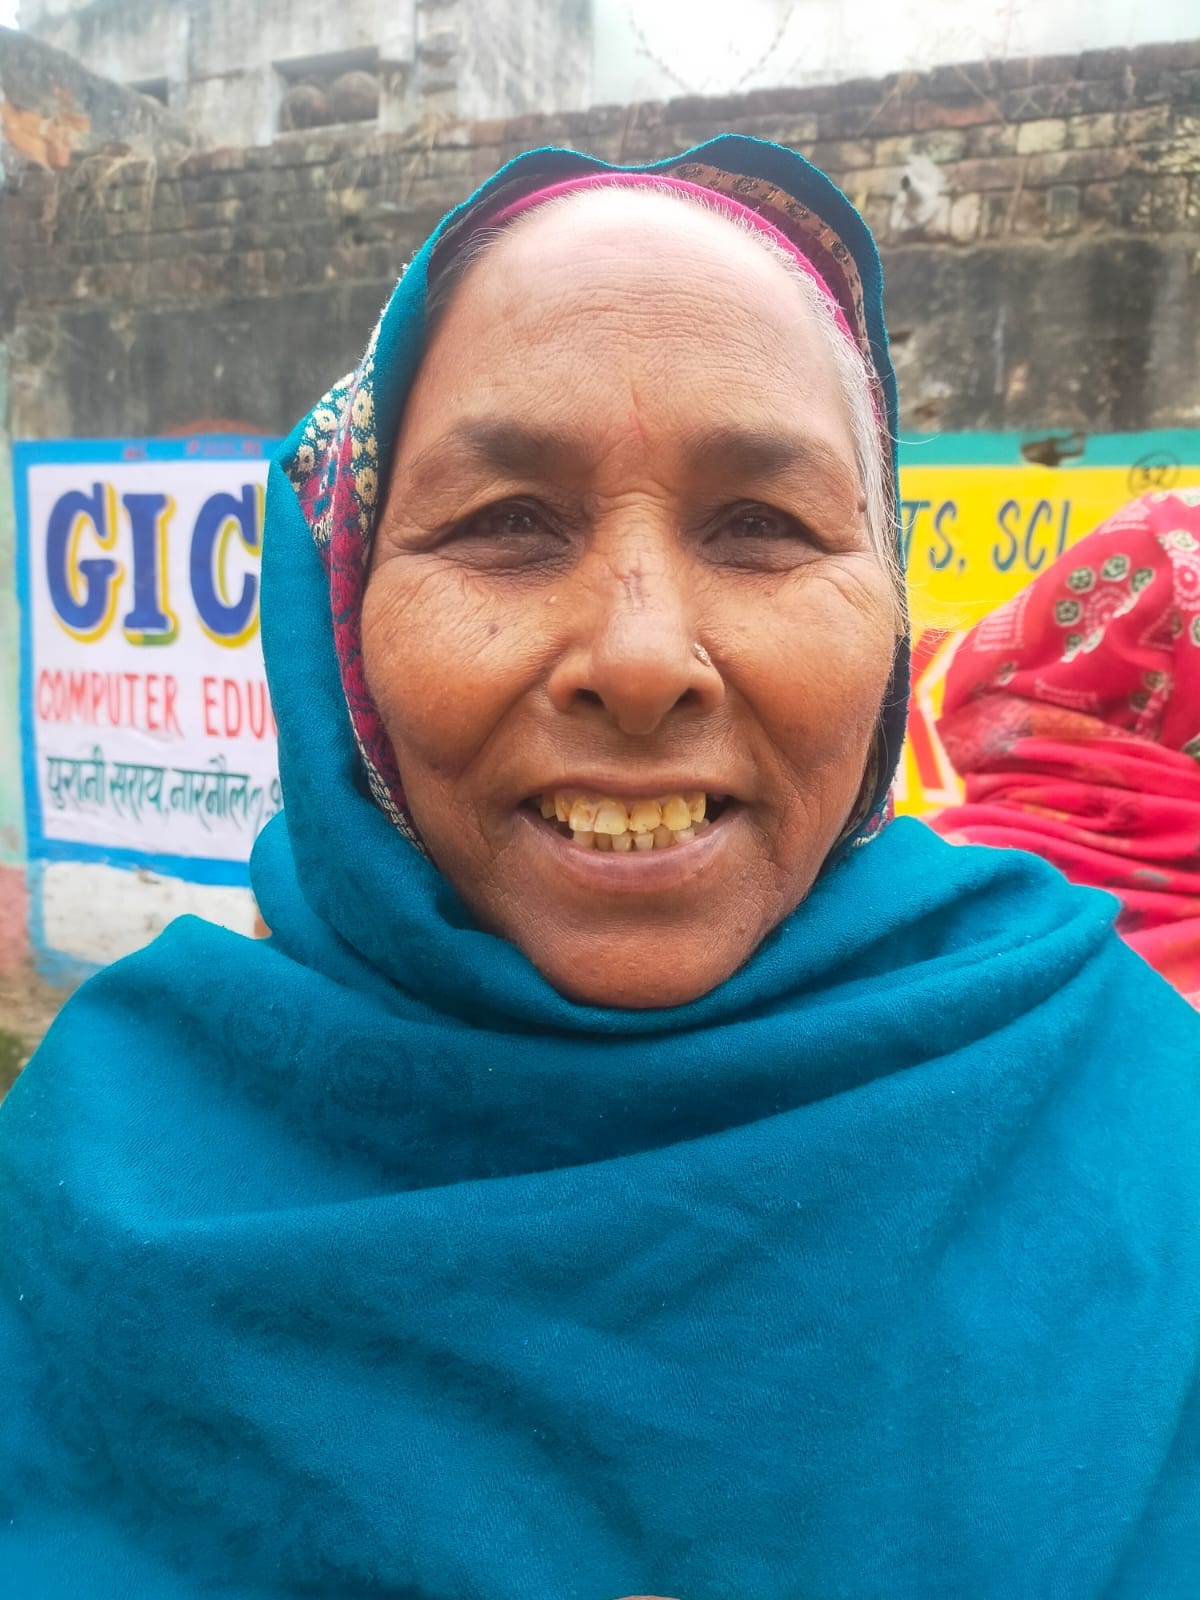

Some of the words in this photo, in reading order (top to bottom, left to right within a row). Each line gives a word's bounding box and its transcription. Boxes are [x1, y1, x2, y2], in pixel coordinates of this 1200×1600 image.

[46, 482, 266, 647] GIC
[36, 669, 184, 739] COMPUTER
[201, 676, 277, 740] EDU
